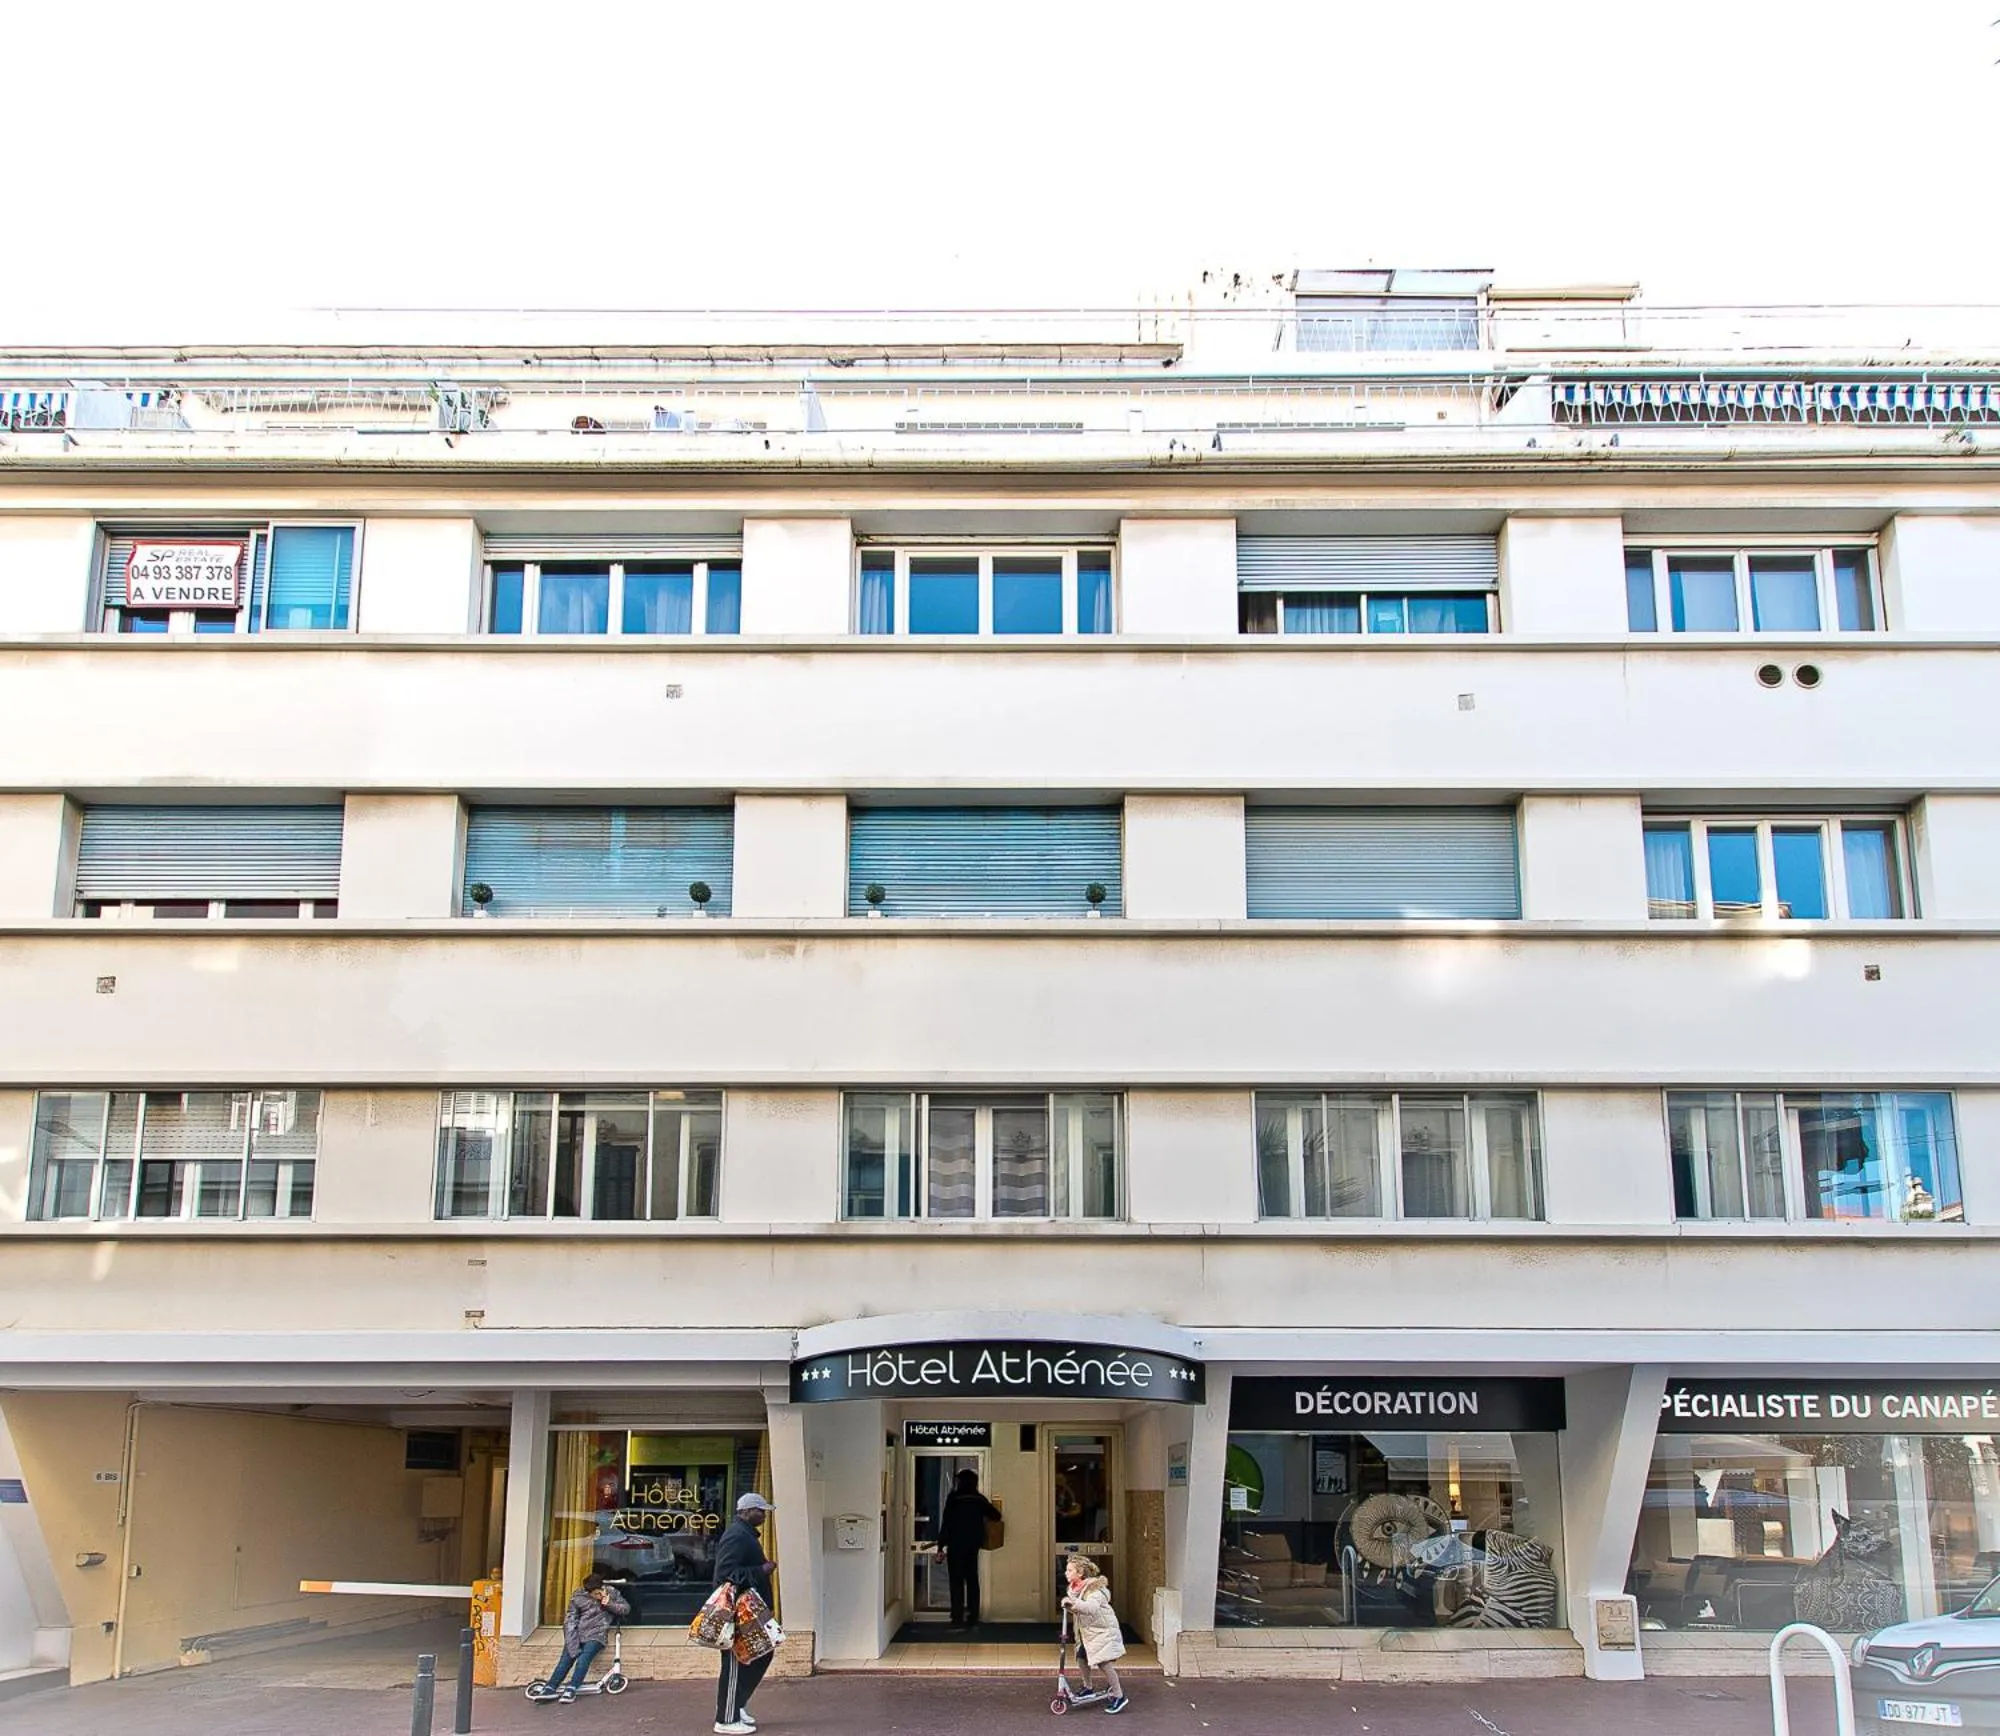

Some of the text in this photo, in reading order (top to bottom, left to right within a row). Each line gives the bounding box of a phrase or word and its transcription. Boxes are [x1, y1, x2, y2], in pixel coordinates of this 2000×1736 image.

[131, 564, 233, 580] 04 93 387 378
[132, 586, 233, 601] A VENDRE
[847, 1349, 1154, 1388] Hôtel Athénée
[1295, 1385, 1479, 1415] DÉCORATION
[1830, 1394, 1872, 1418] DU
[1881, 1389, 2000, 1418] CANAPÉ
[910, 1424, 987, 1436] Hôtel Athénée
[631, 1481, 701, 1504] Hôtel
[609, 1507, 720, 1530] Athénée
